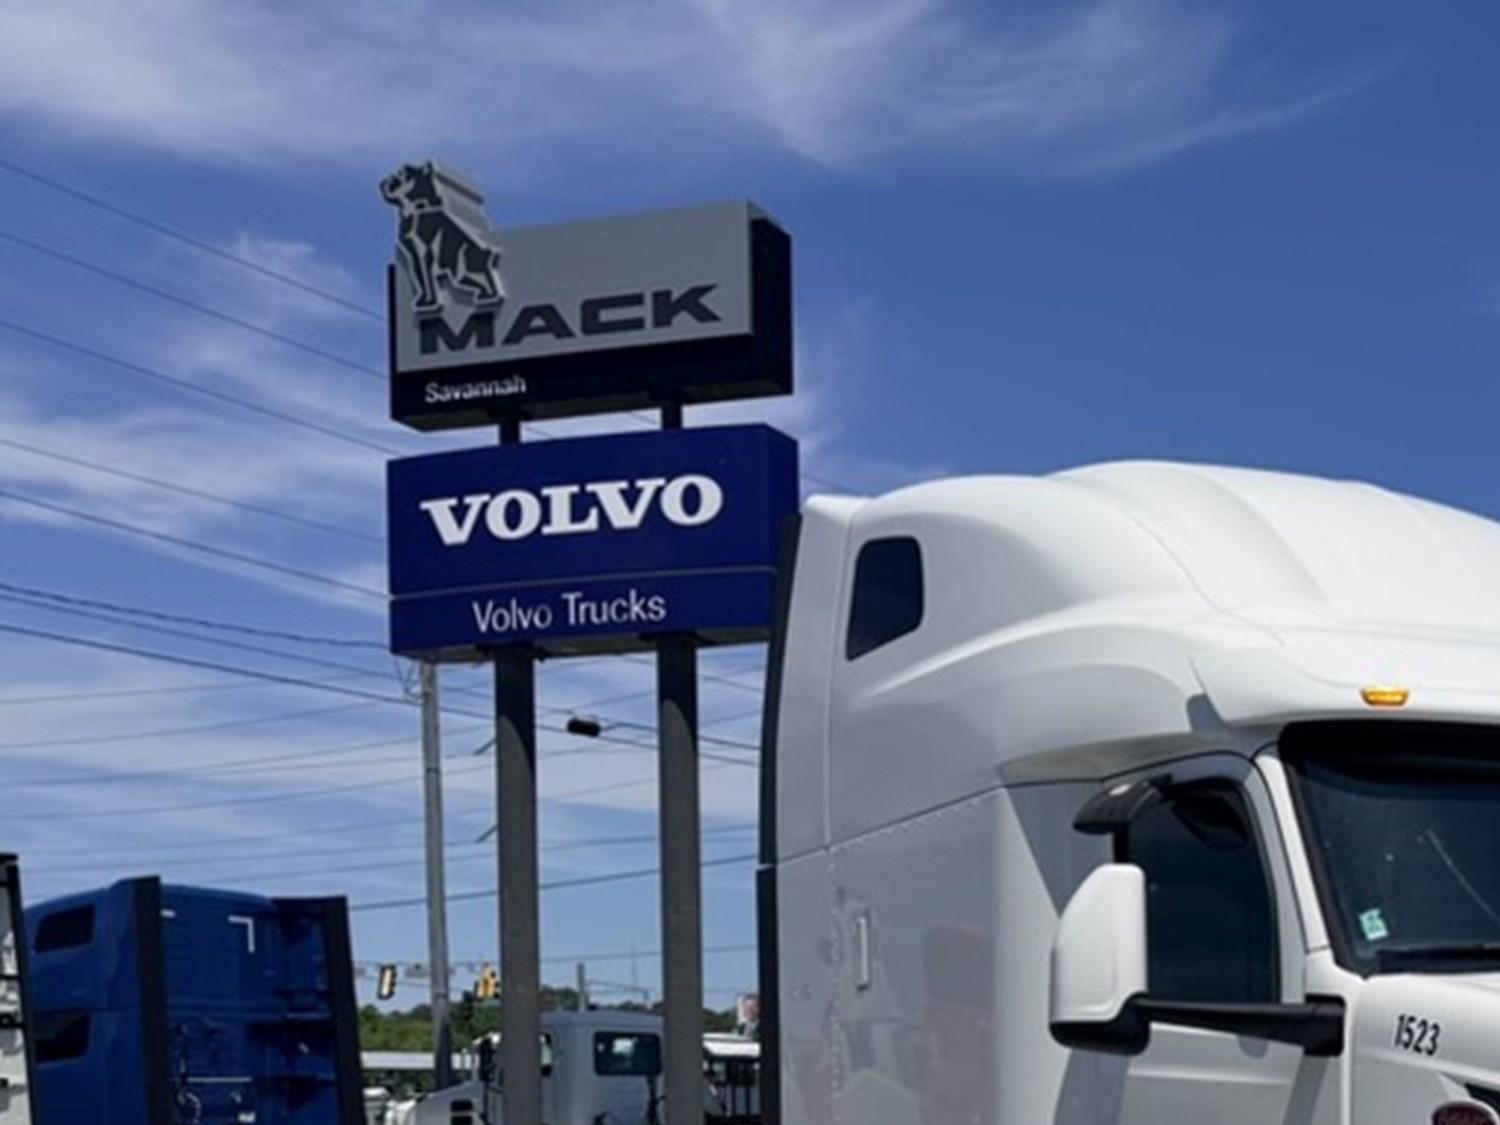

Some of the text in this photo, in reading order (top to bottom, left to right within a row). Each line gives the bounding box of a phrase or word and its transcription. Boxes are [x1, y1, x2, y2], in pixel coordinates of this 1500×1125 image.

[419, 284, 720, 355] MACK
[425, 375, 526, 403] Savannah
[420, 474, 723, 546] VOLVO
[472, 589, 666, 634] Volvo Trucks
[1394, 1014, 1440, 1056] 1523
